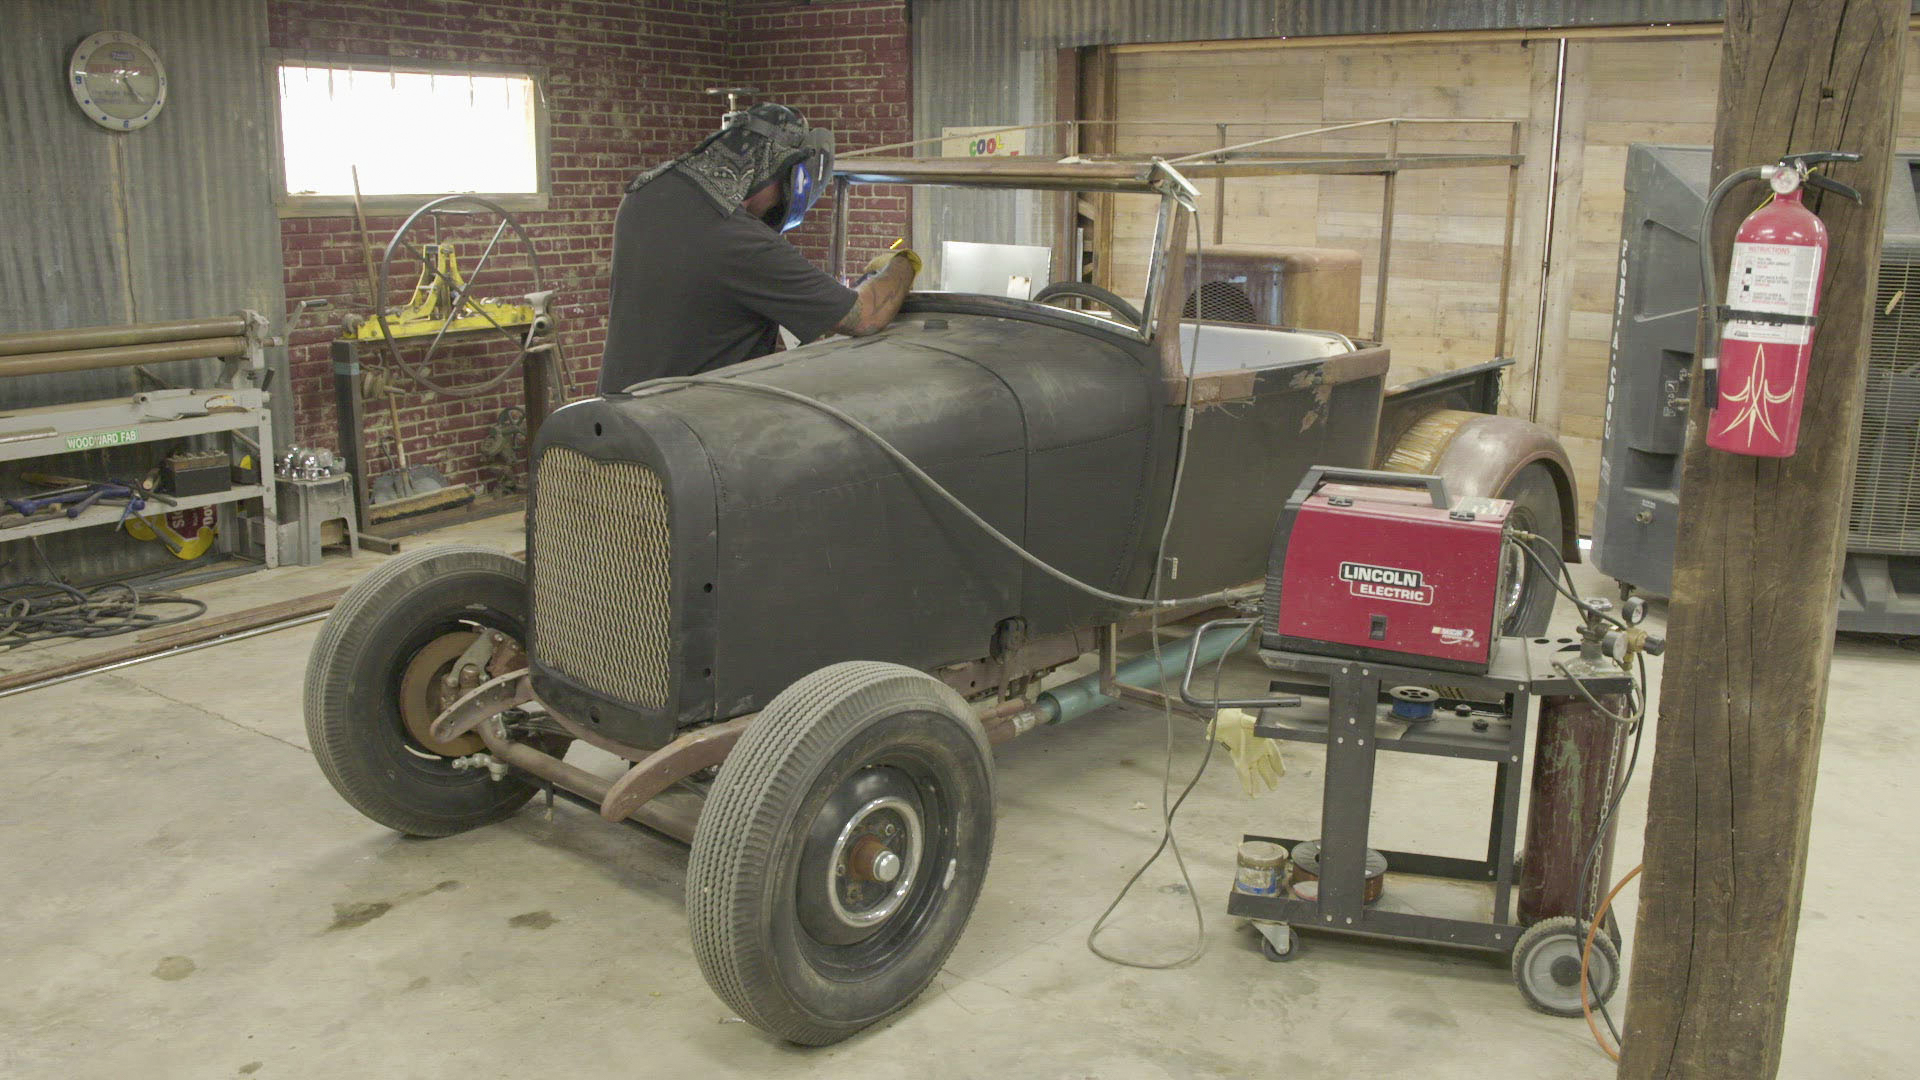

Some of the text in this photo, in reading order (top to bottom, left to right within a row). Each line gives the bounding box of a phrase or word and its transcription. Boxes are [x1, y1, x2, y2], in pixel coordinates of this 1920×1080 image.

[969, 134, 1004, 157] COOL
[120, 430, 137, 443] FAB
[1344, 565, 1418, 588] LINCOLN
[1360, 583, 1424, 602] ELECTRIC
